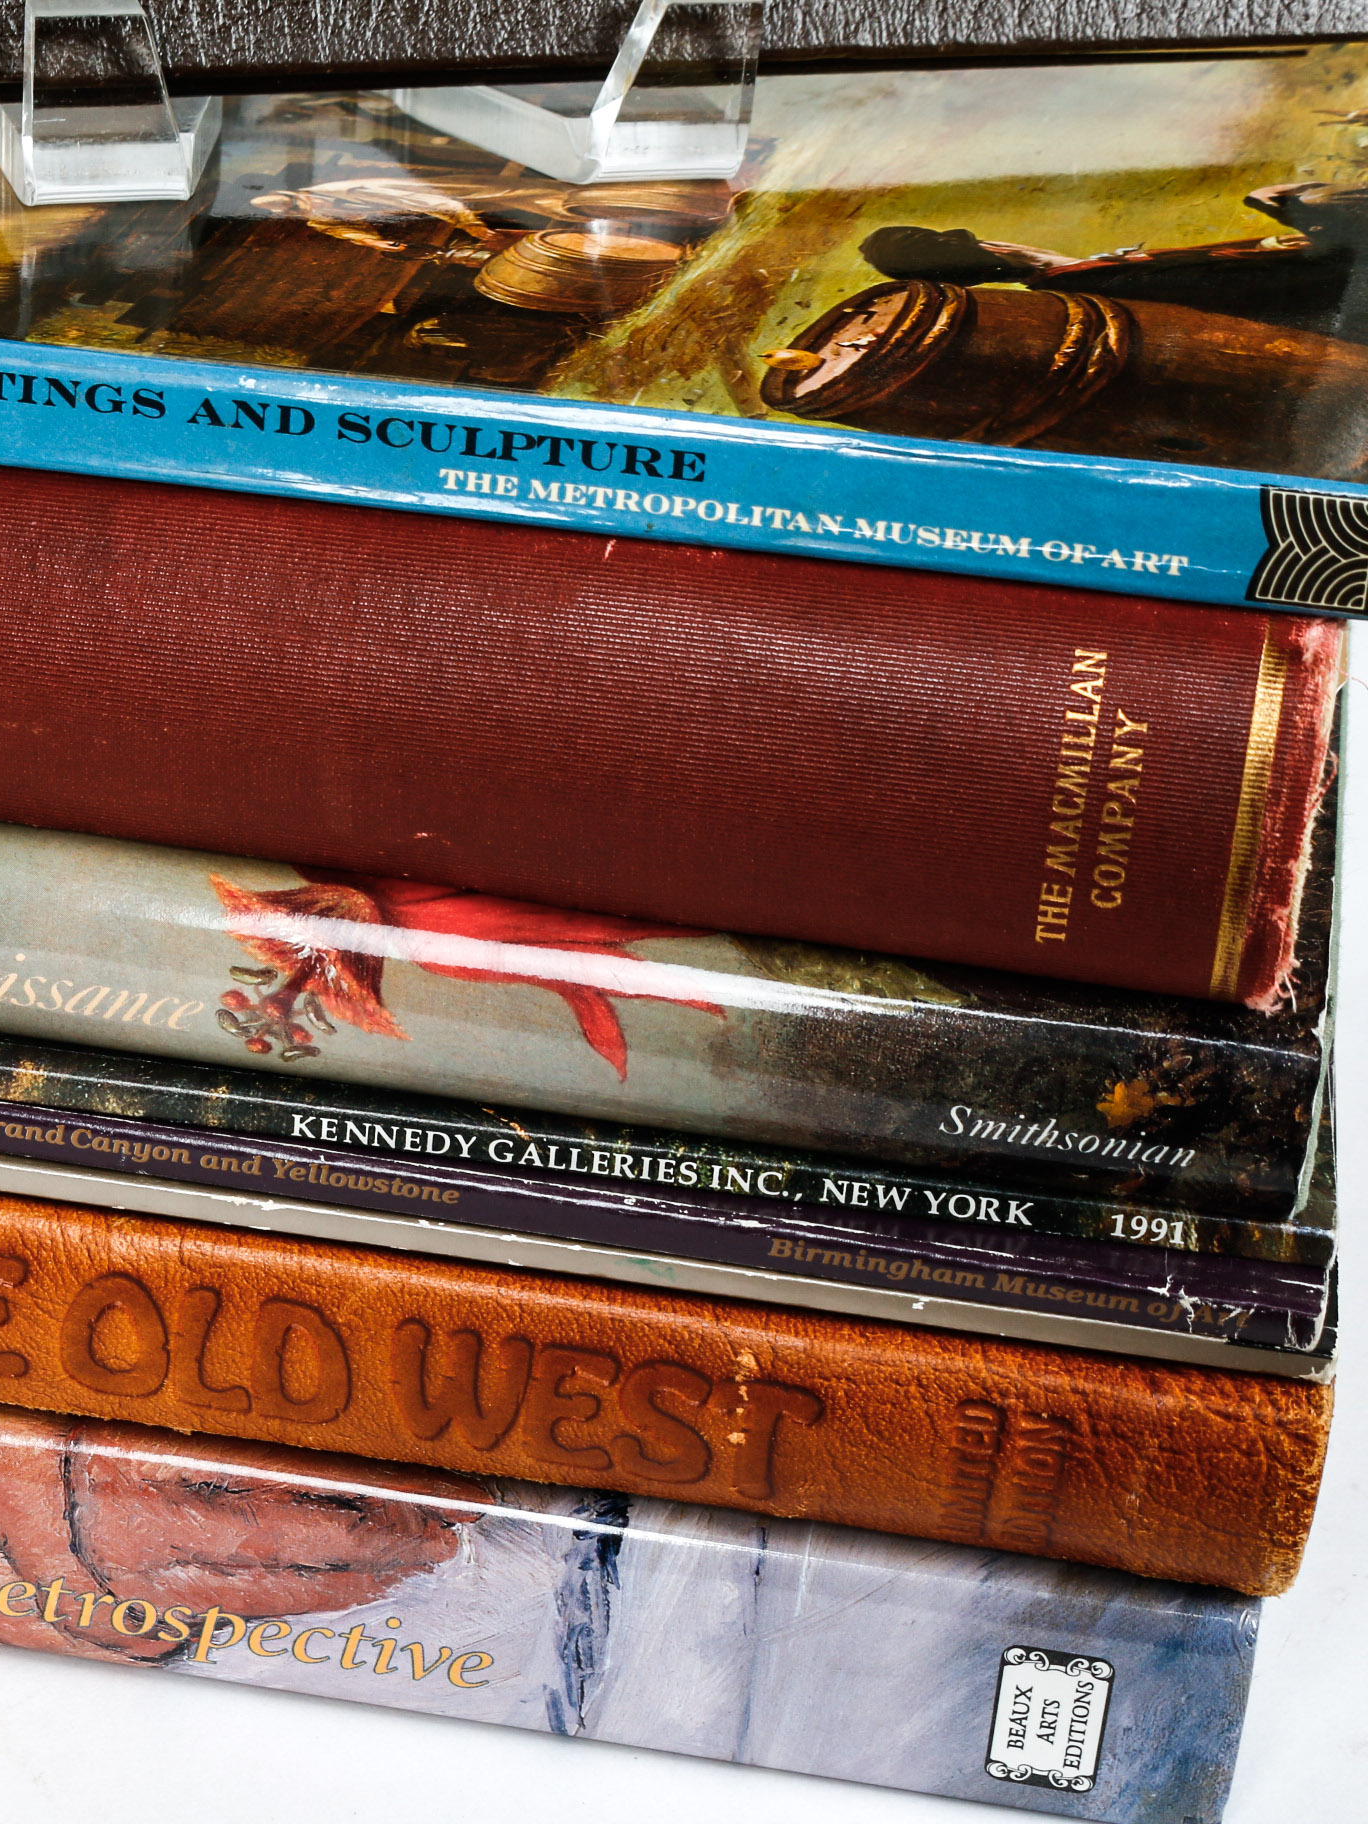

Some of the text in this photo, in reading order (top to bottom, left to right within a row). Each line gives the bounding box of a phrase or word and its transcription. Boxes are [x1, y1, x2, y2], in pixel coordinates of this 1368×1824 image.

[187, 397, 314, 436] AND
[337, 412, 707, 482] SCULPTURE
[440, 468, 1189, 578] THE METROPOLITAN MUSEUM OF ART
[1035, 649, 1108, 944] THE MACMILLAN
[1090, 708, 1148, 909] COMPANY
[71, 1127, 191, 1166] Canyon
[200, 1150, 262, 1176] and
[272, 1157, 460, 1206] Yellowstone
[291, 1114, 1184, 1245] KENNEDY GALLERIES INC., NEW YORK 1991
[938, 1104, 1196, 1168] Smithsonian
[768, 1238, 986, 1292] Birmingham
[993, 1274, 1140, 1313] Museum
[1147, 1299, 1184, 1324] of
[60, 1273, 352, 1424] OLD
[391, 1317, 825, 1500] WEST
[1007, 1684, 1033, 1750] BEAUX
[1036, 1699, 1061, 1745] ARTS
[1063, 1680, 1094, 1770] EDITIONS
